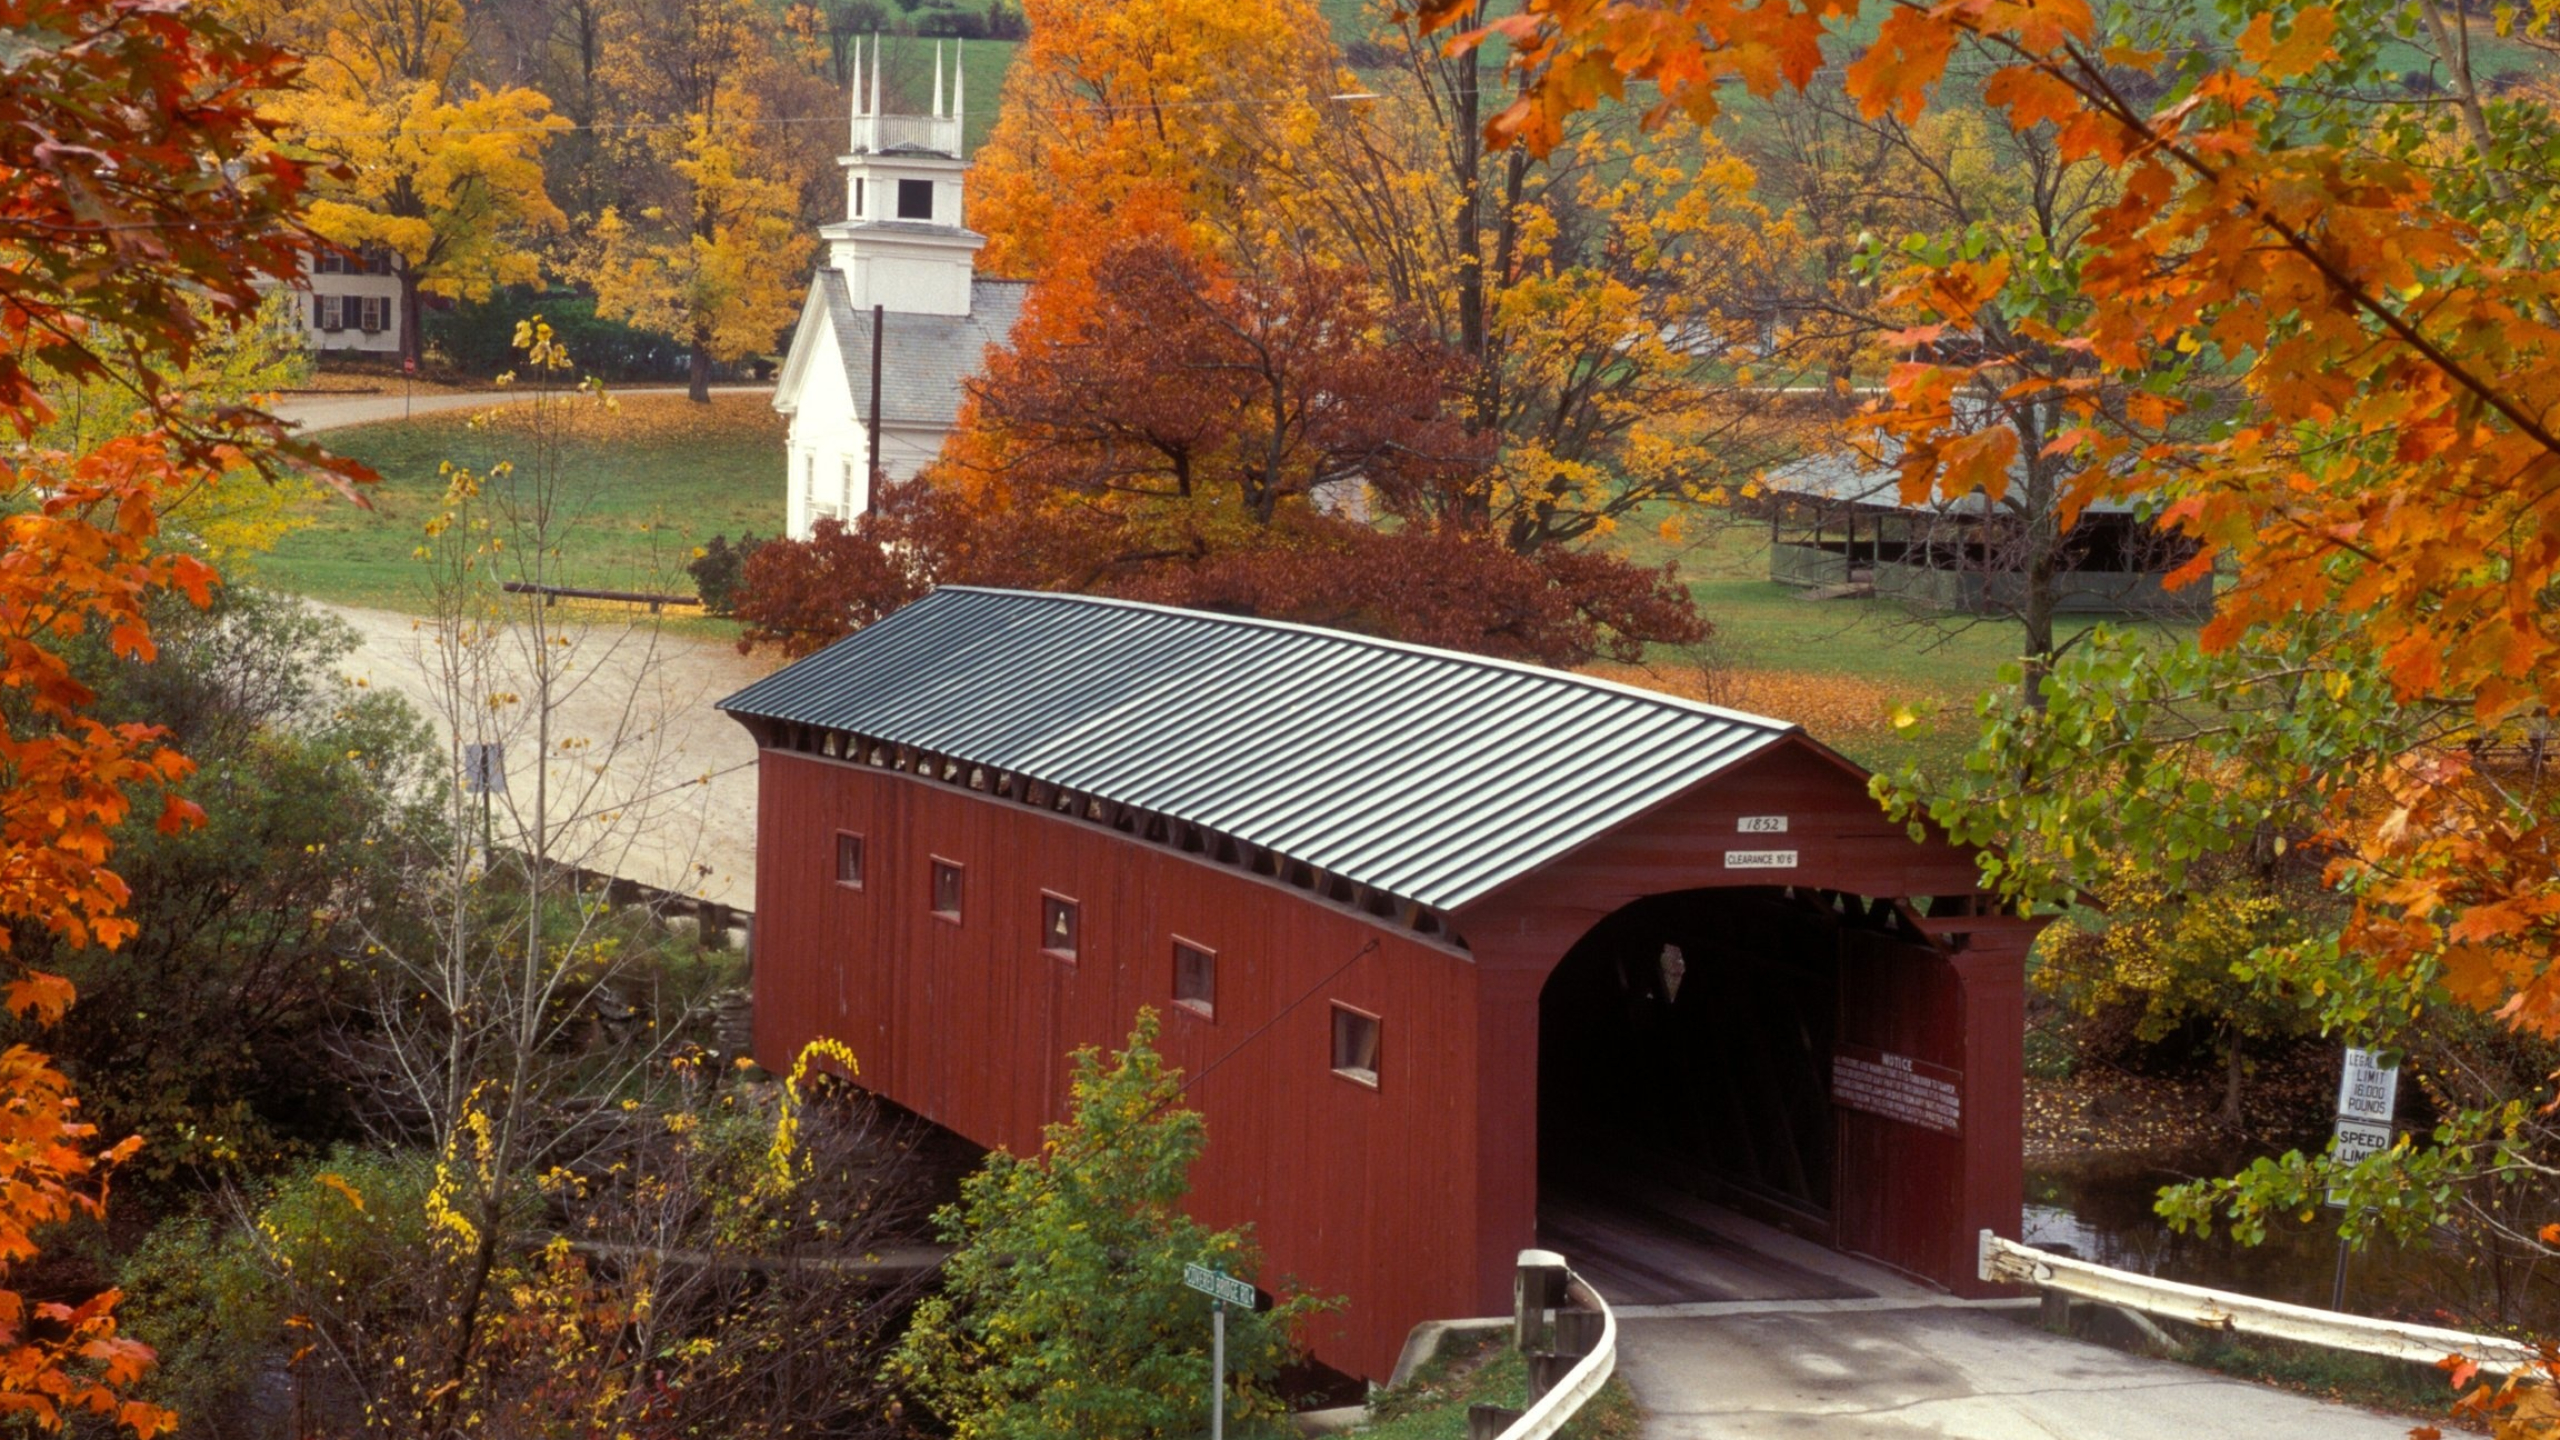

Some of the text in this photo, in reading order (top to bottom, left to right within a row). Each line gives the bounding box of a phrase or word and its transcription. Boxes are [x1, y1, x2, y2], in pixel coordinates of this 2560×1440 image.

[1746, 818, 1779, 830] 1852
[1727, 854, 1774, 865] CLEARANCE
[1882, 1053, 1912, 1072] NOTICE
[2349, 1053, 2374, 1069] LEGAL
[2357, 1069, 2385, 1084] LIMIT
[2348, 1097, 2386, 1115] POUNDS
[2340, 1131, 2386, 1148] SPEED
[1187, 1266, 1215, 1292] COVERED
[1216, 1276, 1239, 1301] BRIDGE
